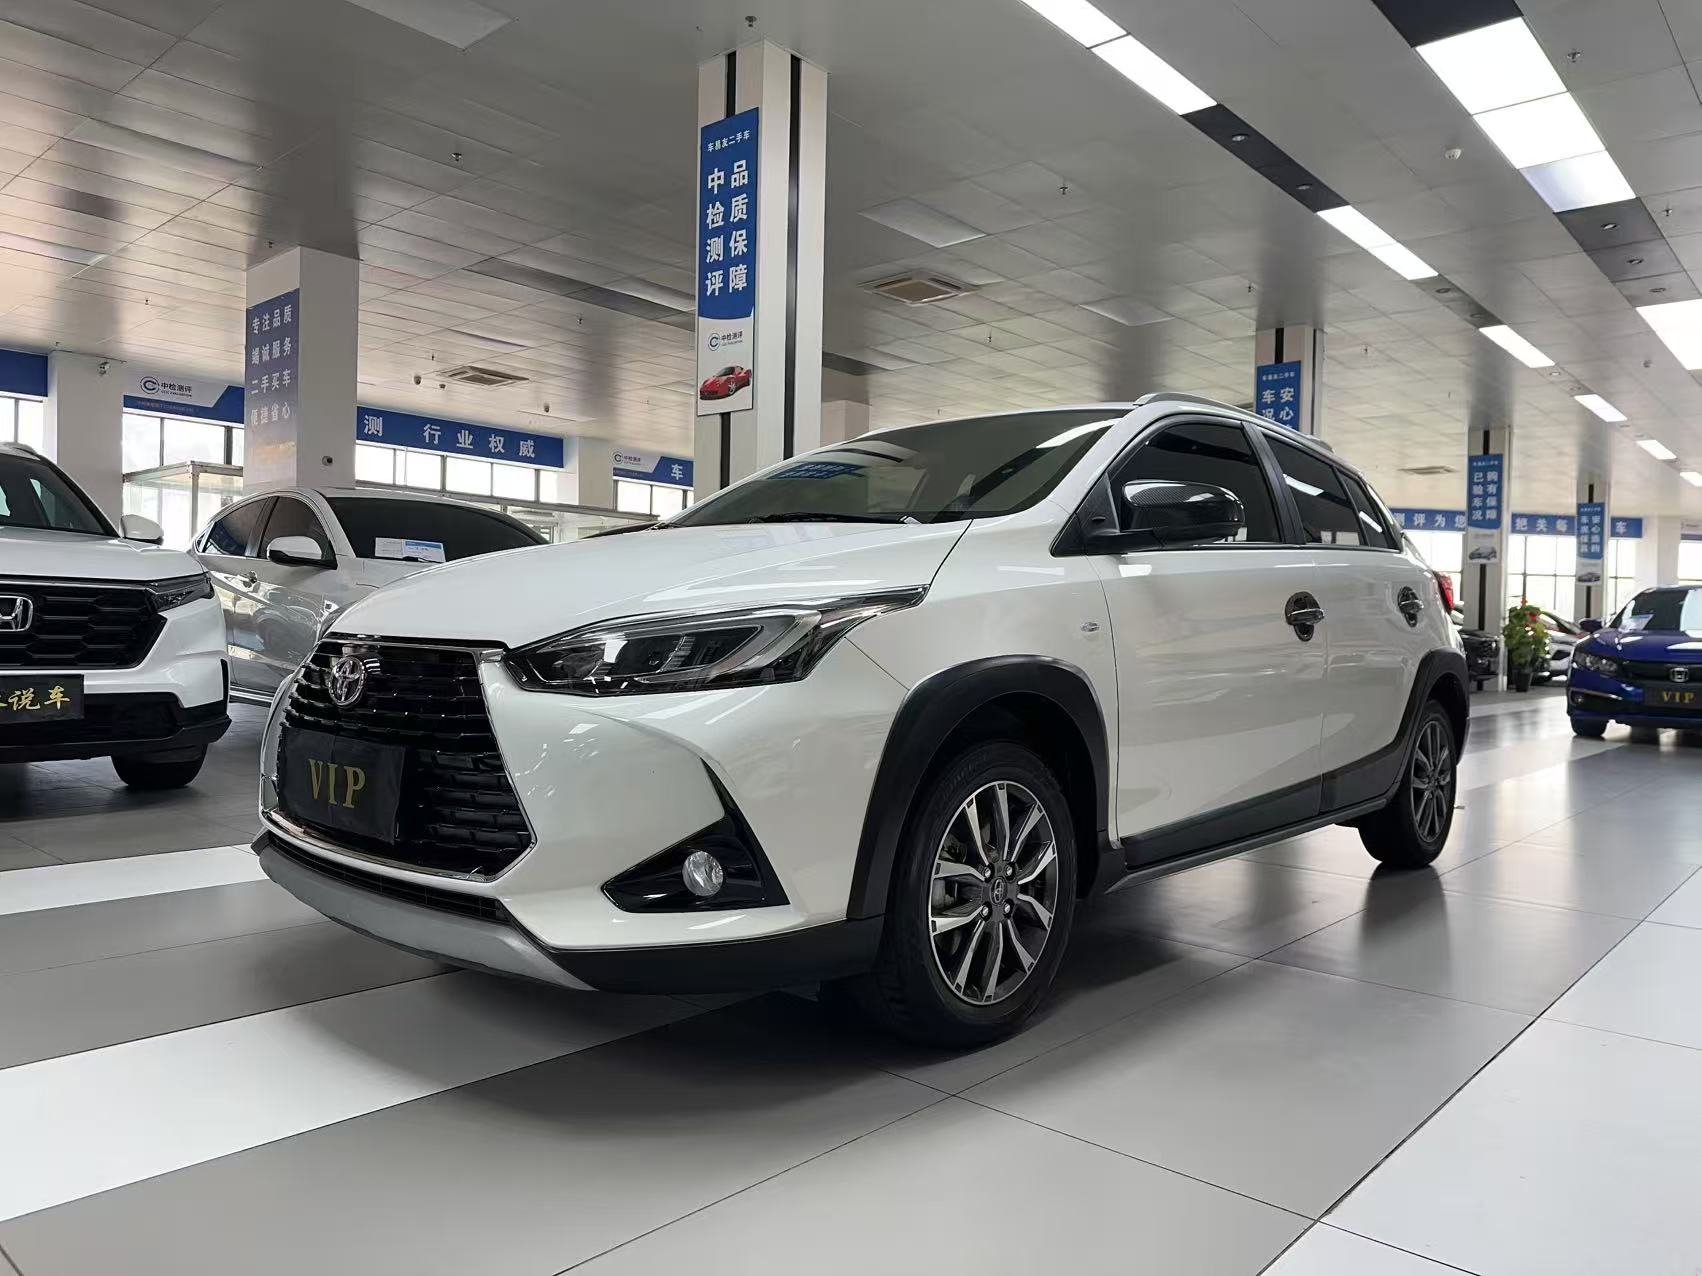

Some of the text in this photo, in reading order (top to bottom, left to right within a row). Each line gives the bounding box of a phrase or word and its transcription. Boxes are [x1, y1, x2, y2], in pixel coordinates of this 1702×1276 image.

[707, 130, 750, 152] 车易友二手车
[706, 168, 725, 296] 中检测评
[729, 159, 749, 293] 品质保障
[252, 304, 292, 334] 专注品质
[161, 382, 193, 394] 中检测评
[251, 369, 291, 395] 二手买车
[364, 414, 536, 459] 测 行业权威
[671, 464, 684, 480] 车
[1615, 521, 1627, 535] 车
[1663, 691, 1694, 703] VIP
[308, 758, 366, 809] VIP
